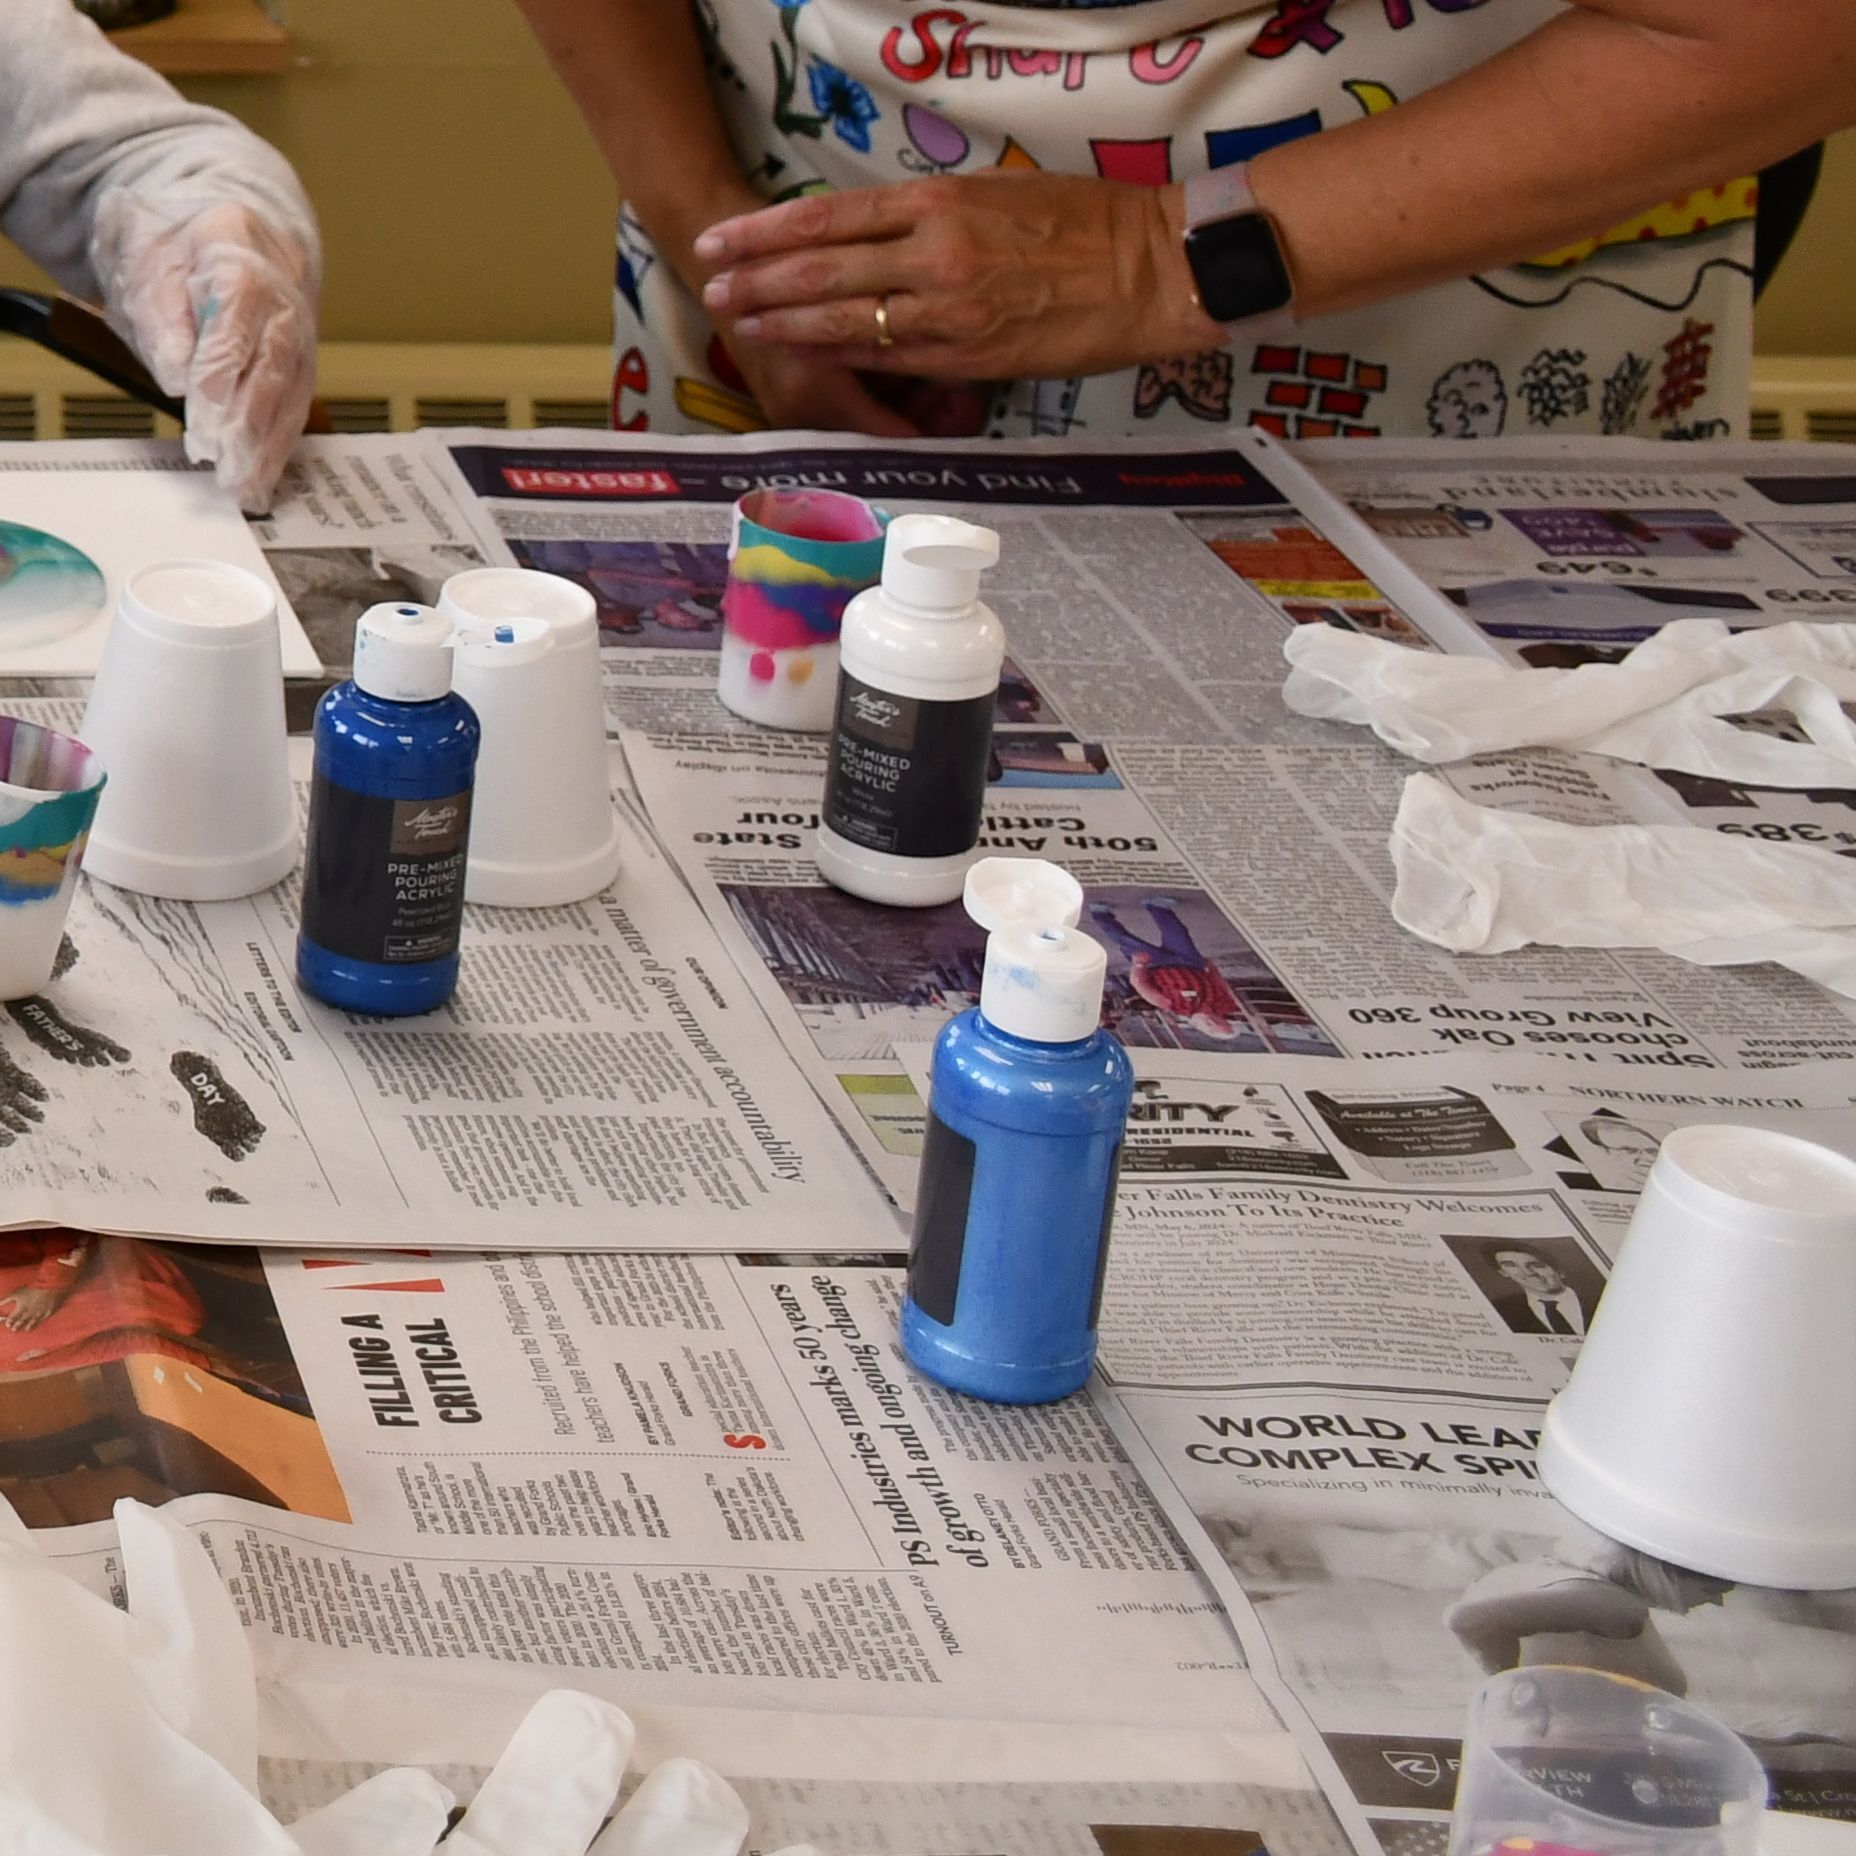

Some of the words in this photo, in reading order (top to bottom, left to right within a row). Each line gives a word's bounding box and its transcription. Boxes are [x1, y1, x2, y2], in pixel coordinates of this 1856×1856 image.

[506, 468, 679, 494] faster!
[720, 464, 846, 492] more
[863, 464, 971, 492] your
[982, 469, 1084, 496] Find
[840, 748, 901, 781] POURING
[840, 764, 897, 793] ACRYLIC
[989, 814, 1086, 832] Cattl
[692, 832, 802, 849] State
[1064, 836, 1159, 853] 50th
[387, 852, 464, 876] PRE-MIXED
[394, 868, 458, 888] POURING
[395, 882, 456, 902] ACRYLIC
[1350, 1006, 1423, 1025] 360
[1429, 1005, 1556, 1029] Group
[1572, 1007, 1672, 1028] View
[606, 905, 653, 957] matter
[642, 970, 729, 1069] government
[712, 1063, 806, 1185] accountability
[1433, 1026, 1515, 1047] Oak
[1522, 1028, 1690, 1047] chooses
[189, 1070, 226, 1108] DAY
[1492, 1082, 1531, 1095] Page
[1568, 1084, 1726, 1109] NORTHERN
[1725, 1094, 1804, 1110] WATCH
[1147, 1187, 1204, 1202] Falls
[1207, 1187, 1291, 1205] Family
[1298, 1189, 1413, 1215] Dentistry
[1414, 1197, 1543, 1216] Welcomes
[1125, 1205, 1230, 1221] Johnson
[1230, 1204, 1265, 1219] To
[1270, 1204, 1305, 1220] Its
[1311, 1206, 1405, 1228] Practice
[492, 1283, 534, 1335] Philippines
[524, 1280, 560, 1311] school
[769, 1282, 811, 1336] years
[809, 1274, 863, 1341] change
[340, 1313, 385, 1331] A
[547, 1332, 583, 1366] helped
[795, 1336, 829, 1361] 50
[348, 1335, 420, 1428] FILLING
[405, 1317, 483, 1425] CRITICAL
[521, 1356, 554, 1382] from
[563, 1368, 595, 1394] have
[841, 1343, 906, 1419] ongoing
[533, 1384, 577, 1436] Recruited
[810, 1364, 866, 1430] marks
[574, 1395, 616, 1443] teachers
[1197, 1413, 1408, 1441] WORLD
[887, 1423, 931, 1462] and
[1184, 1442, 1446, 1474] COMPLEX
[1450, 1452, 1540, 1481] SPI
[848, 1431, 920, 1537] Industries
[1235, 1473, 1368, 1494] Specializing
[1373, 1477, 1395, 1490] in
[1399, 1479, 1503, 1498] minimally
[906, 1466, 975, 1543] growth
[973, 1492, 996, 1516] OTTO
[1022, 1497, 1052, 1527] FORKS
[986, 1516, 1019, 1556] DELANEY
[1040, 1528, 1071, 1560] GRAND
[901, 1539, 940, 1568] PS
[944, 1544, 990, 1568] of
[1019, 1545, 1043, 1569] Grand
[922, 1602, 964, 1656] TURNOUT
